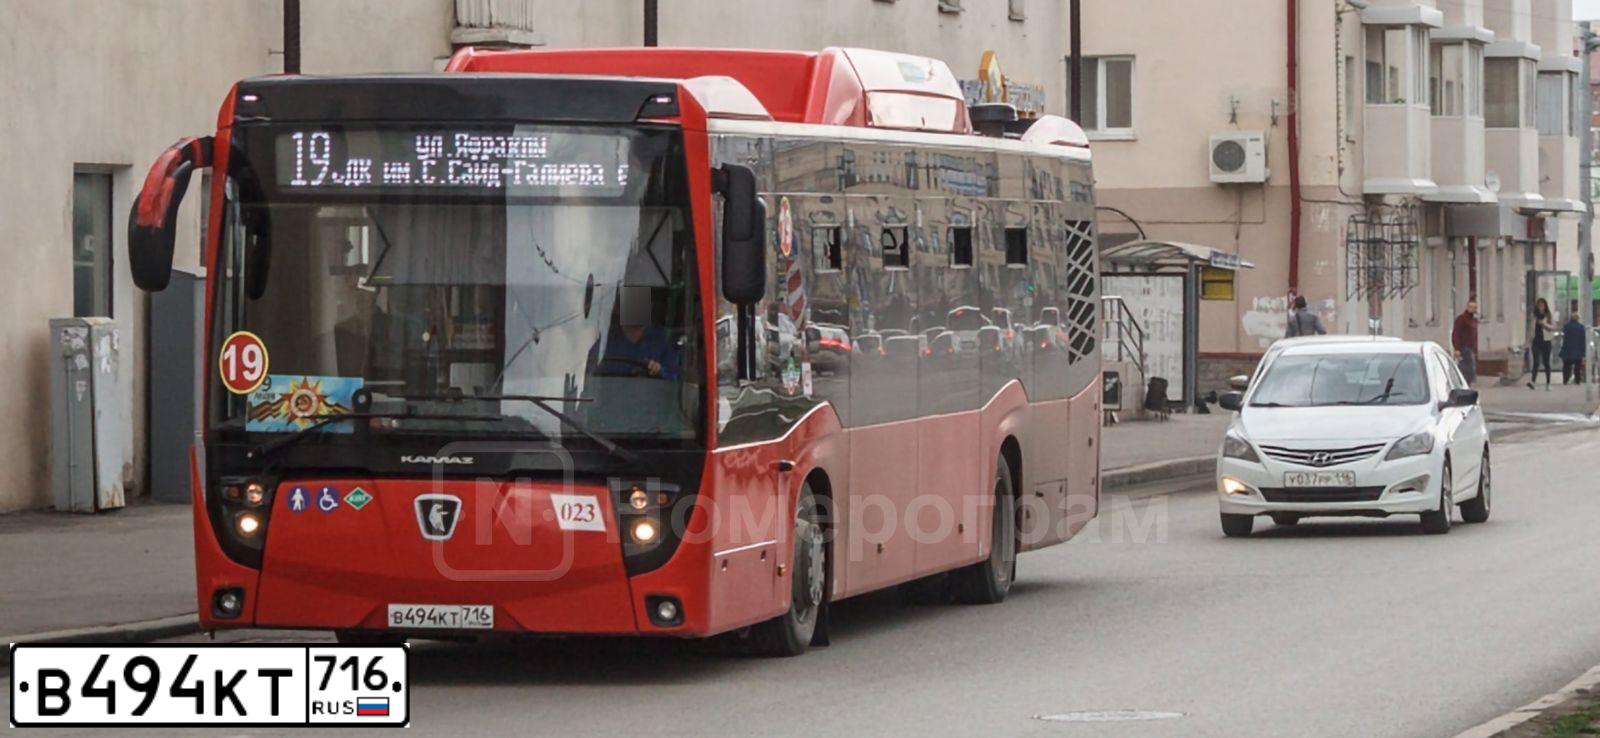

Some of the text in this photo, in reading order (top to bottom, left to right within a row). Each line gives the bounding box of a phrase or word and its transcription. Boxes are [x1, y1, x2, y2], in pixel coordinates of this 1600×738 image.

[290, 132, 330, 186] 19
[224, 343, 264, 382] 19
[561, 503, 596, 523] 023
[462, 607, 491, 621] 716
